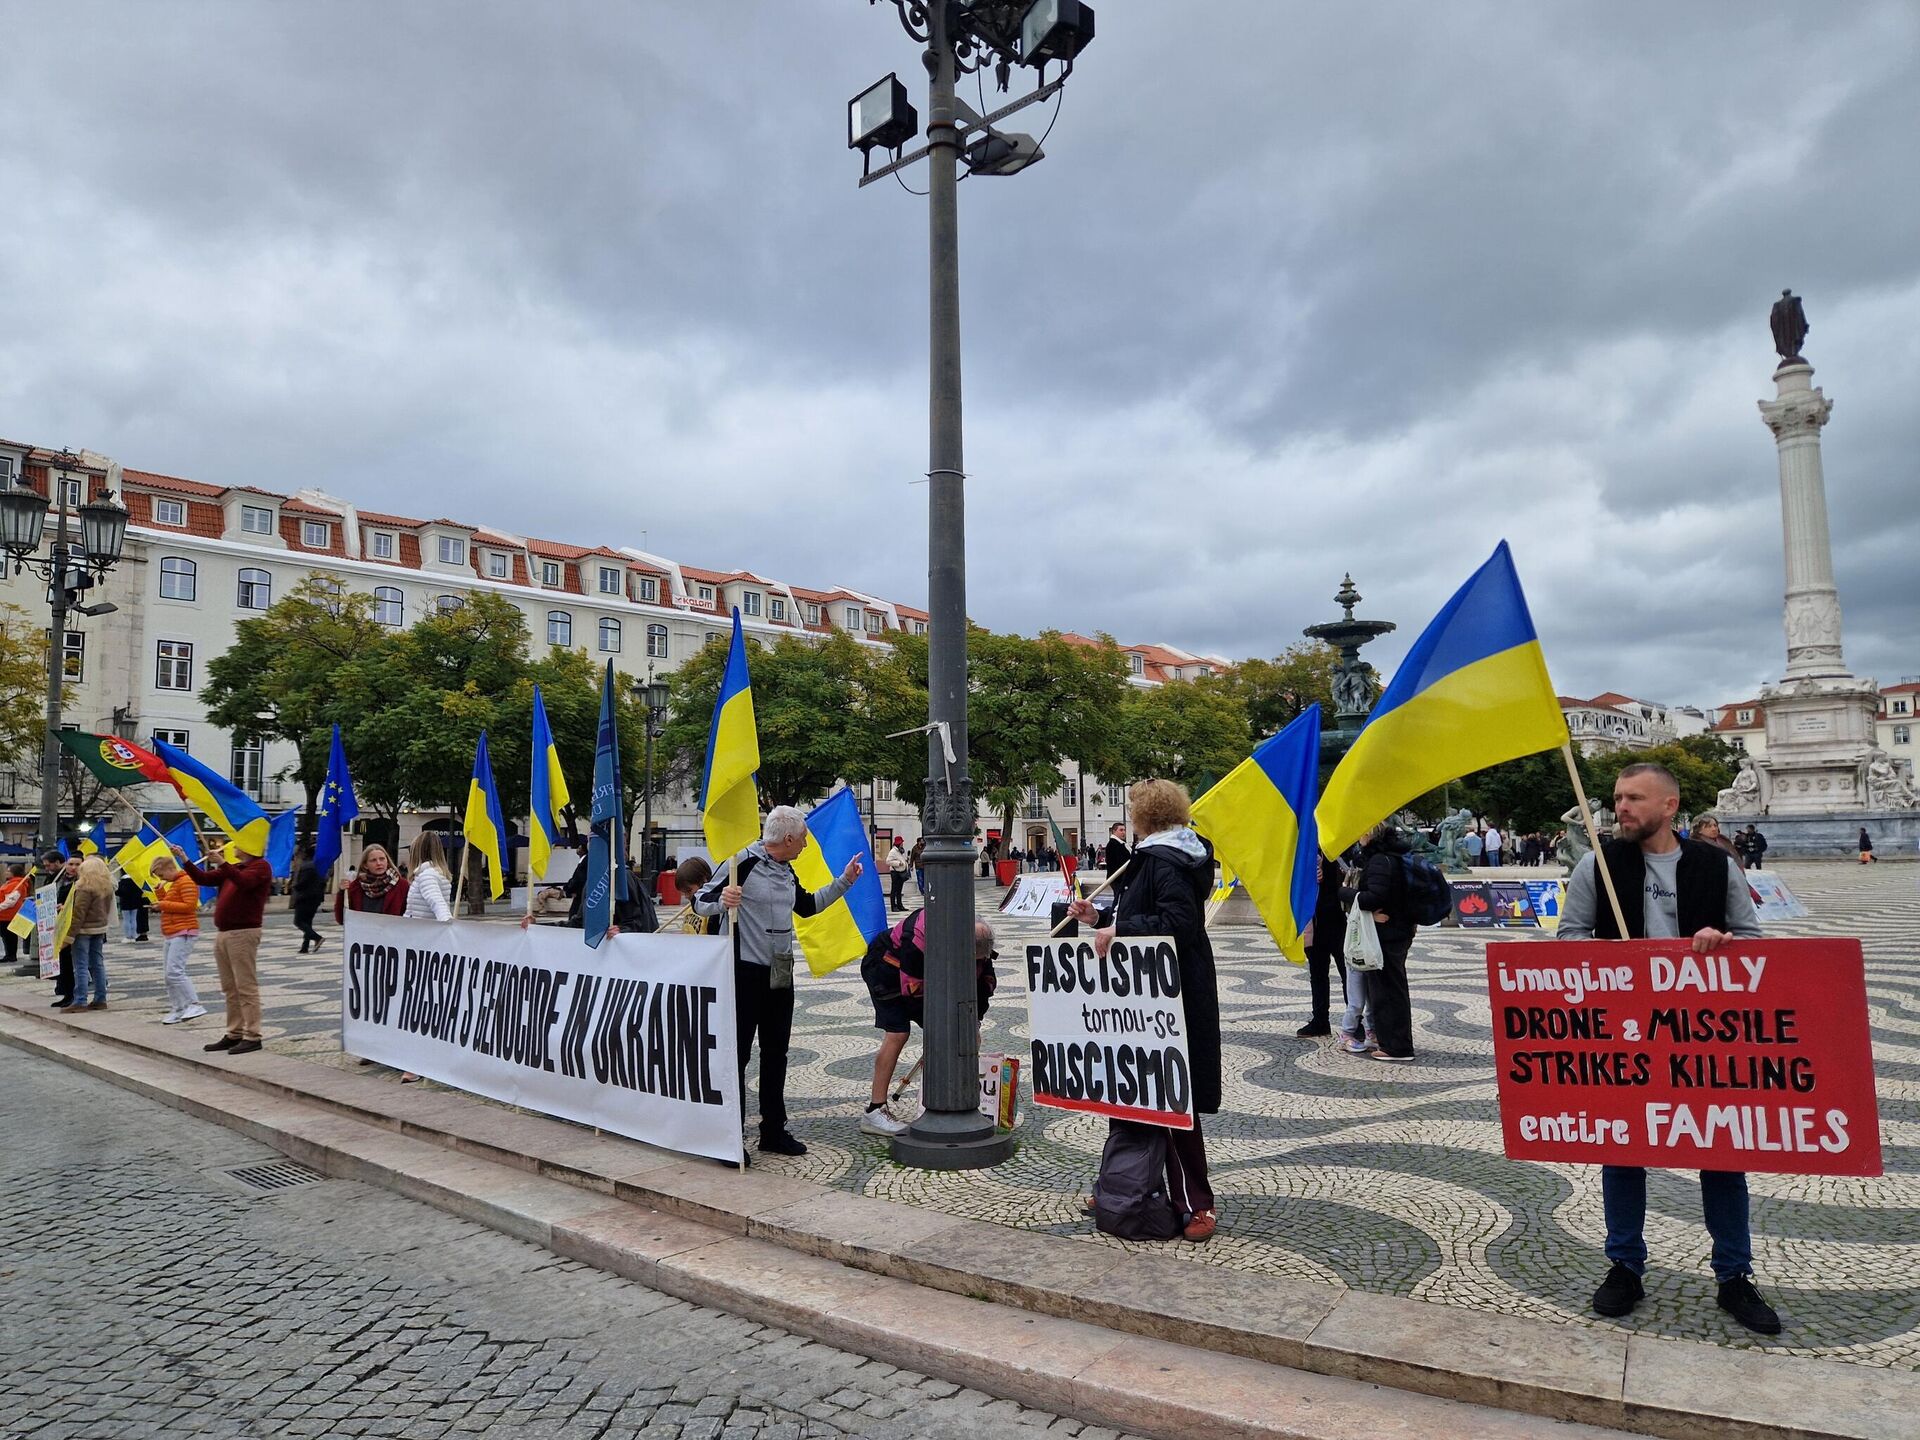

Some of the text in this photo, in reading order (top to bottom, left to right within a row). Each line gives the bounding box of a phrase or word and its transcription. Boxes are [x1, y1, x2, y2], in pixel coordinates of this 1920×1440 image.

[1026, 941, 1181, 999] FASCISMO
[1498, 956, 1767, 1004] imagine DAILY
[348, 942, 724, 1106] STOP RUSSIA'S GENOCIDE IN UKRAINE
[1081, 1003, 1181, 1040] tornou-se
[1504, 1006, 1614, 1041] DRONE
[1647, 1008, 1799, 1044] MISSILE
[1031, 1039, 1190, 1116] RUSCISMO
[1509, 1051, 1816, 1093] STRIKES KILLING
[1519, 1102, 1851, 1154] entire FAMILIES
